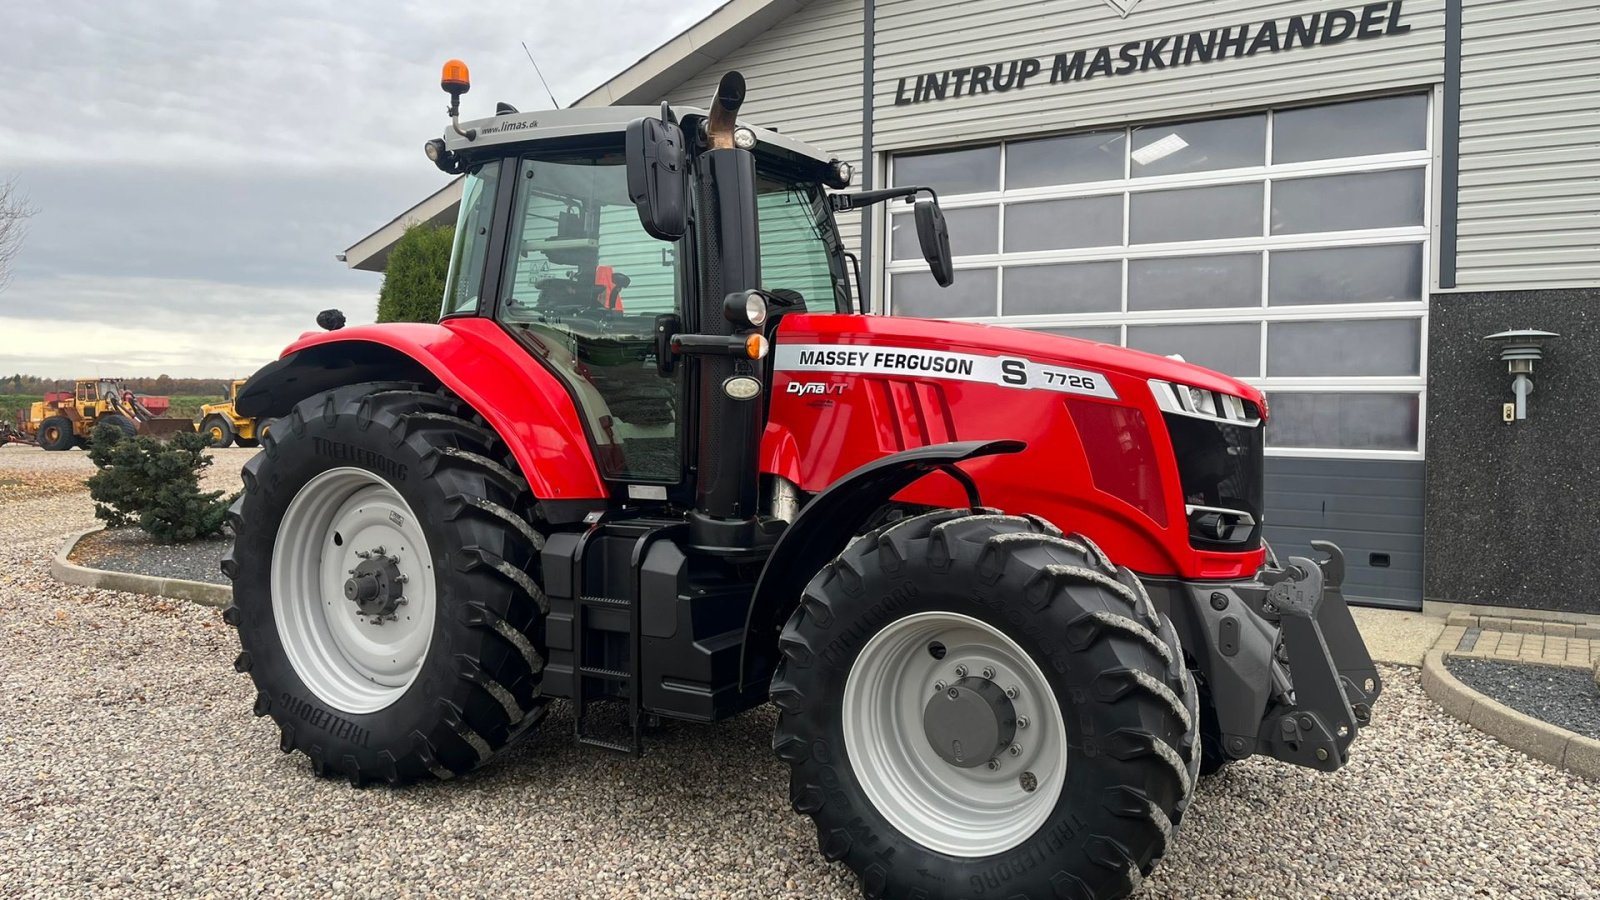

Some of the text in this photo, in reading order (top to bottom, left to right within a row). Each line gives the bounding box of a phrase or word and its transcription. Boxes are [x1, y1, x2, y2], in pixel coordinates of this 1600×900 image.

[895, 0, 1411, 106] LINTRUP MASKINHANDEL
[481, 120, 539, 135] www.limas.dk
[786, 381, 848, 396] DynaVT
[799, 350, 1096, 390] MASSEY FERGUSON S 7726
[312, 436, 408, 482] TRELLEBORG
[819, 580, 920, 667] TRELLEBORG
[279, 692, 371, 749] TRELLEBORG
[969, 813, 1089, 895] TRELLEBORG
